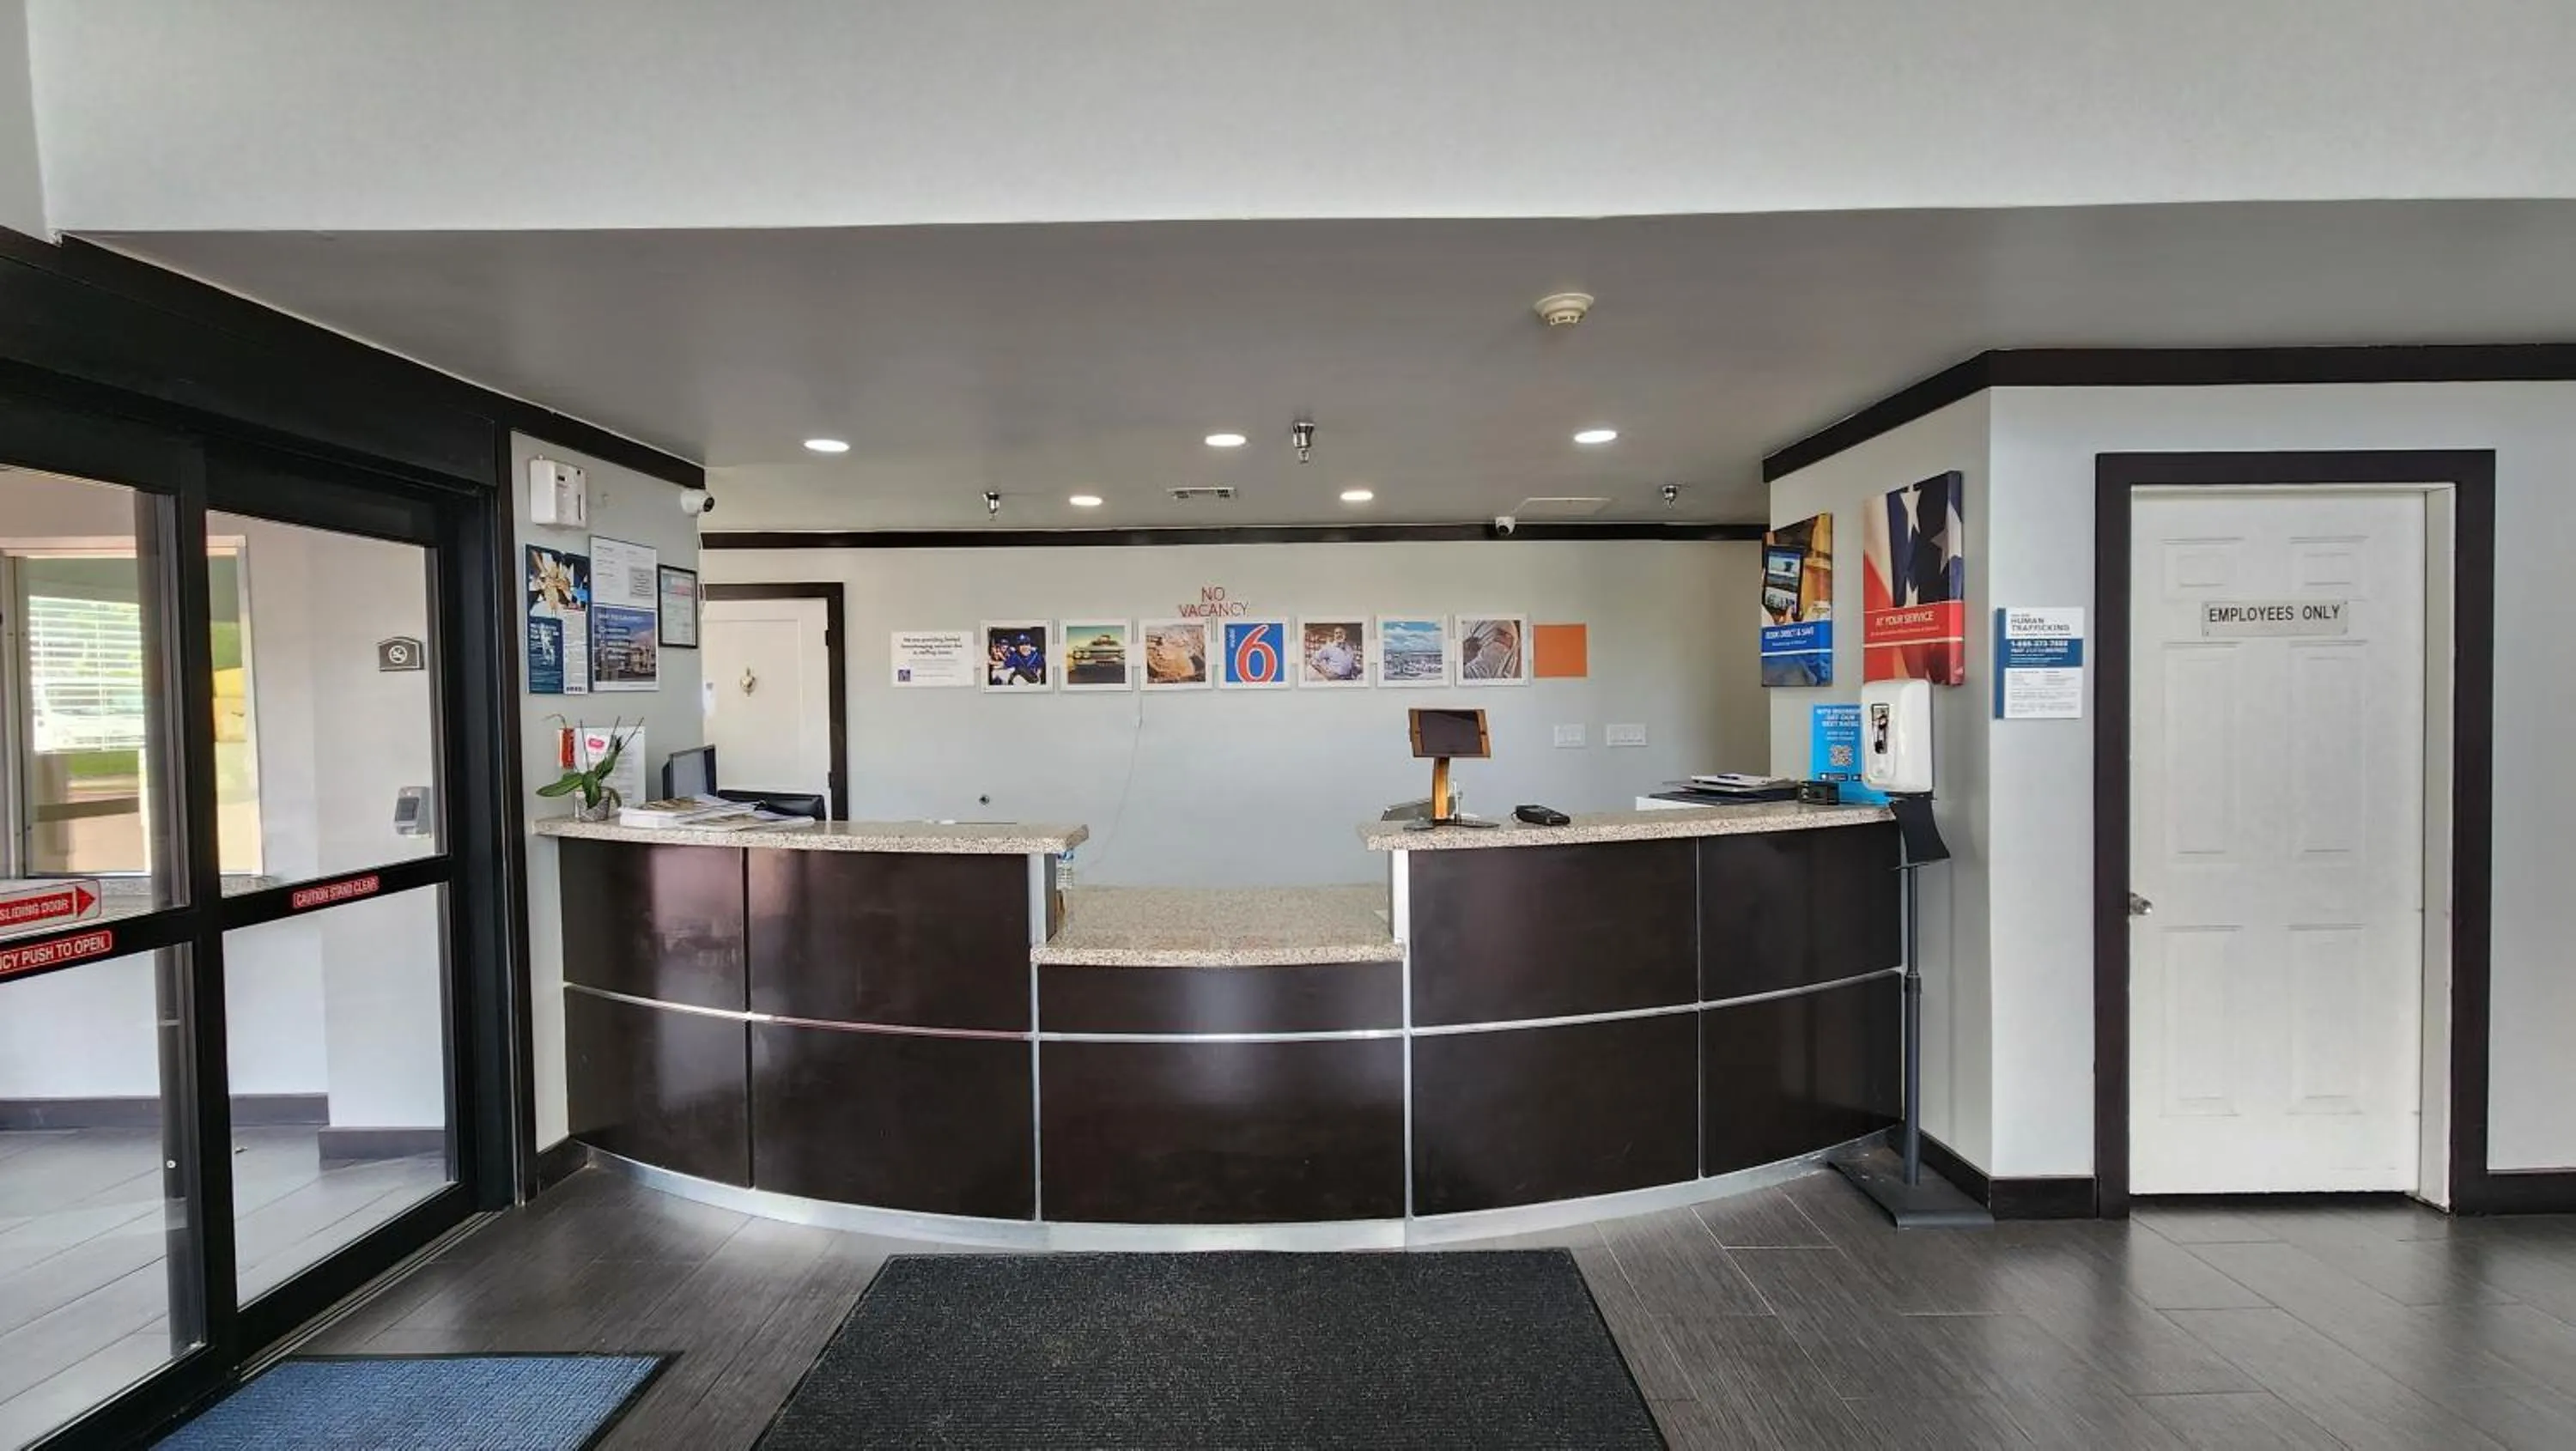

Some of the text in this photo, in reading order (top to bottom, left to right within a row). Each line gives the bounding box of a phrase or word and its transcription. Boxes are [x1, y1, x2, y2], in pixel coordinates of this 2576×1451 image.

[1201, 586, 1225, 602] NO
[1179, 602, 1249, 617] VACANCY
[1886, 615, 1905, 626] YOUR
[1905, 610, 1935, 624] SERVICE
[2208, 604, 2340, 622] EMPLOYEES ONLY
[1234, 624, 1278, 684] 6
[296, 887, 329, 908] CAUTION
[353, 877, 376, 894] CLEAR
[0, 899, 69, 921] SLIDING DOOR
[0, 936, 105, 970] CY PUSH TO OPEN
